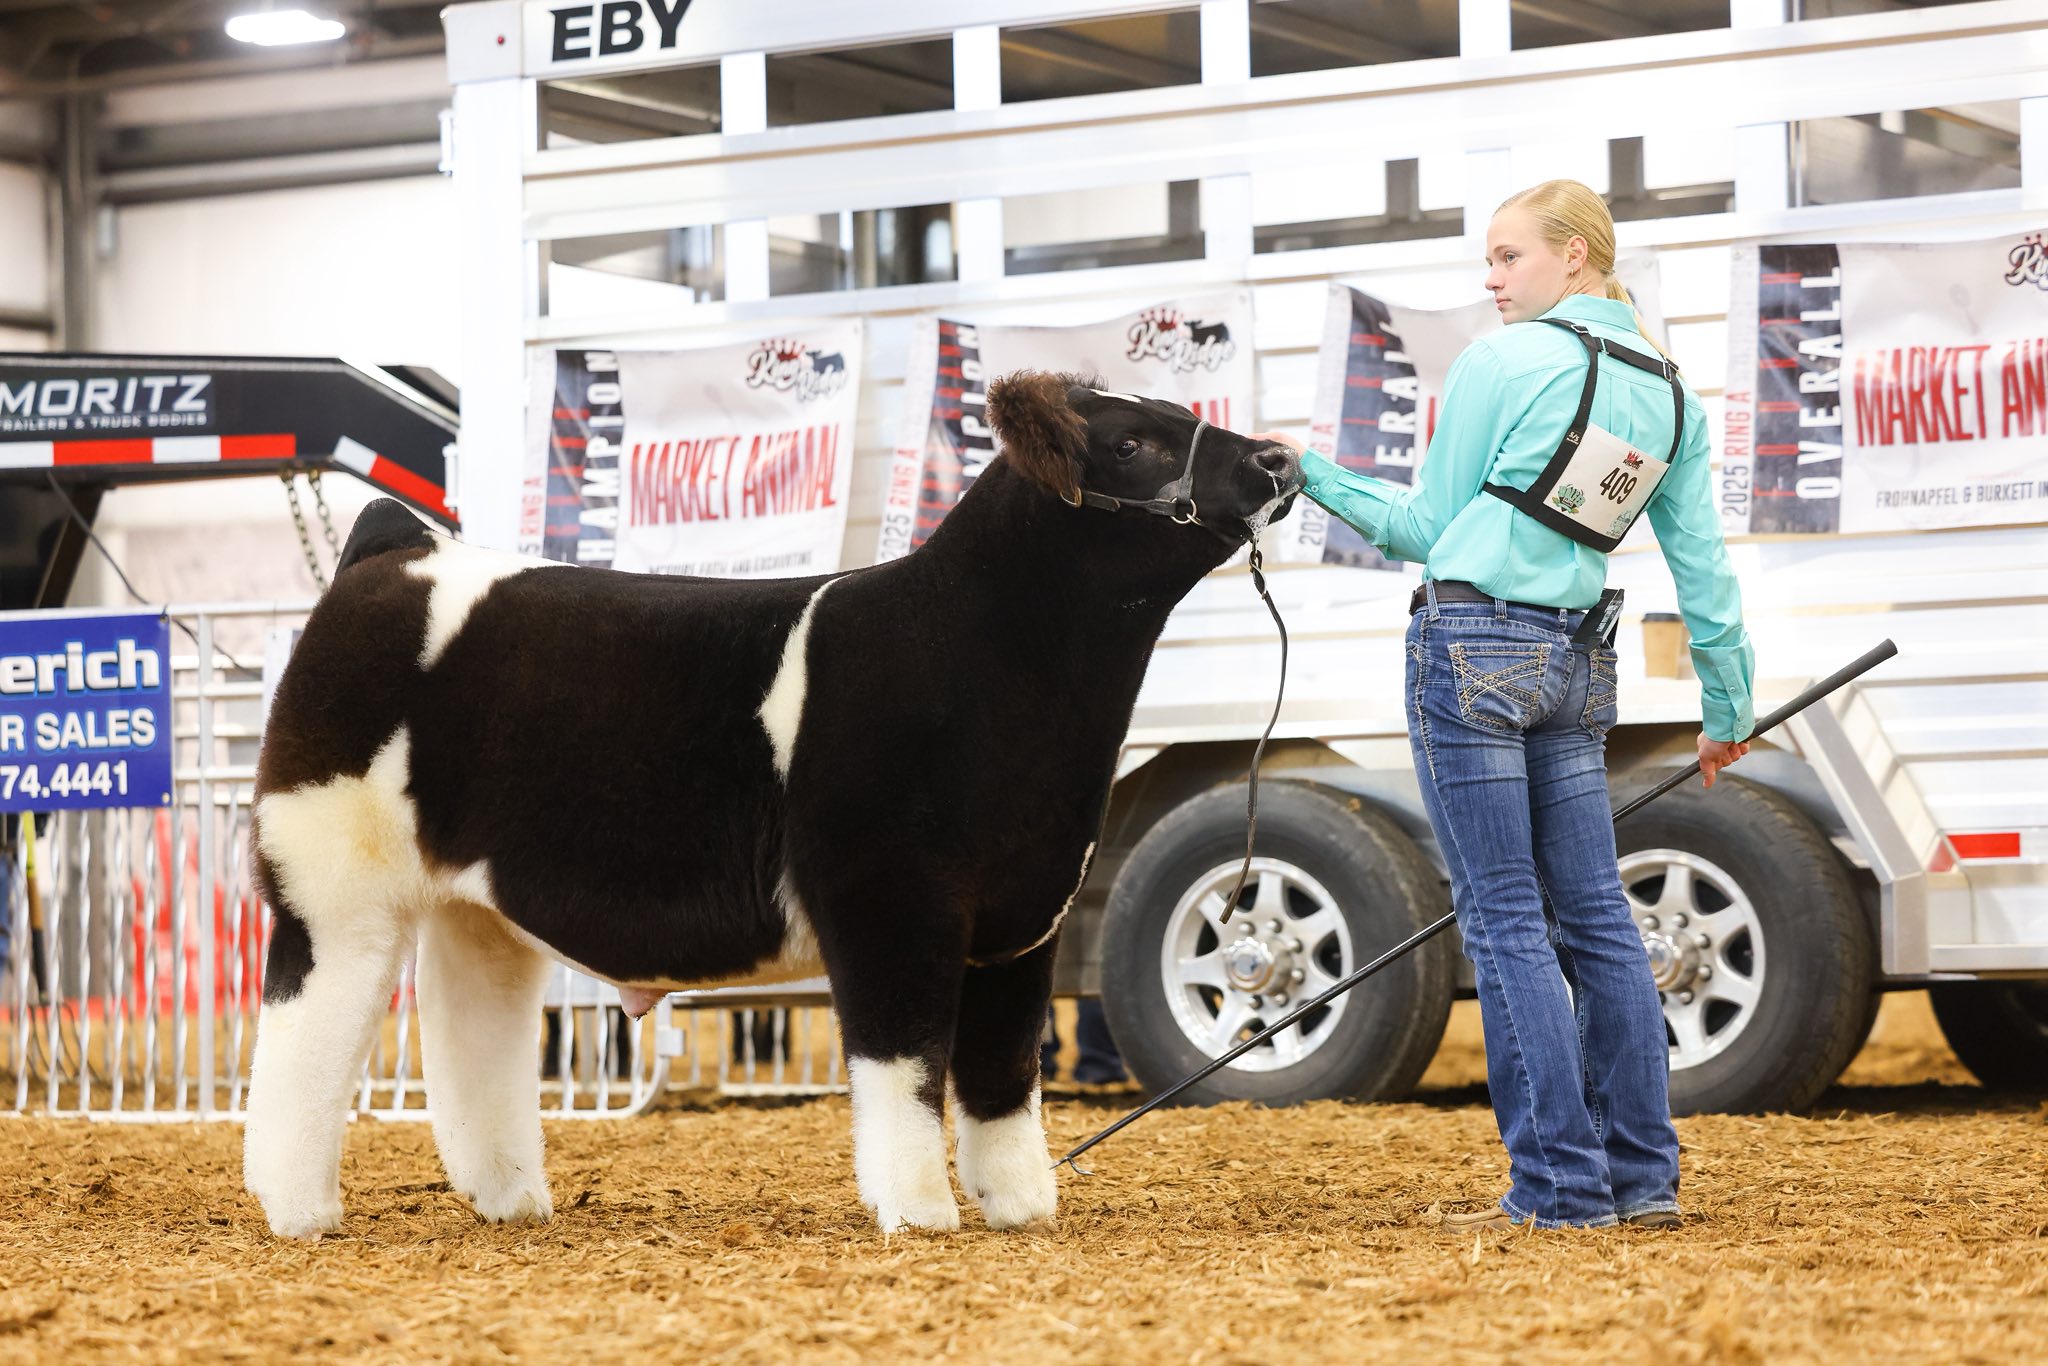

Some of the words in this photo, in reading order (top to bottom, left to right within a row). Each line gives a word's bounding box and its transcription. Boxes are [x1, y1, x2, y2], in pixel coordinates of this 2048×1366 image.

[549, 0, 692, 62] EBY
[0, 373, 212, 417] MORITZ
[1725, 390, 1752, 404] A
[1795, 266, 1842, 499] OVERALL
[1852, 345, 1990, 447] MARKET
[90, 415, 142, 429] TRUCK
[147, 413, 208, 428] BODIES
[1723, 411, 1751, 456] RING
[630, 435, 741, 527] MARKET
[742, 424, 839, 518] ANIMAL
[1600, 467, 1638, 505] 409
[1721, 465, 1749, 517] 2025
[1875, 487, 1958, 508] FROHNAPFEL
[1976, 481, 2033, 503] BURKETT
[36, 707, 156, 751] SALES
[0, 760, 128, 800] 74.4441
